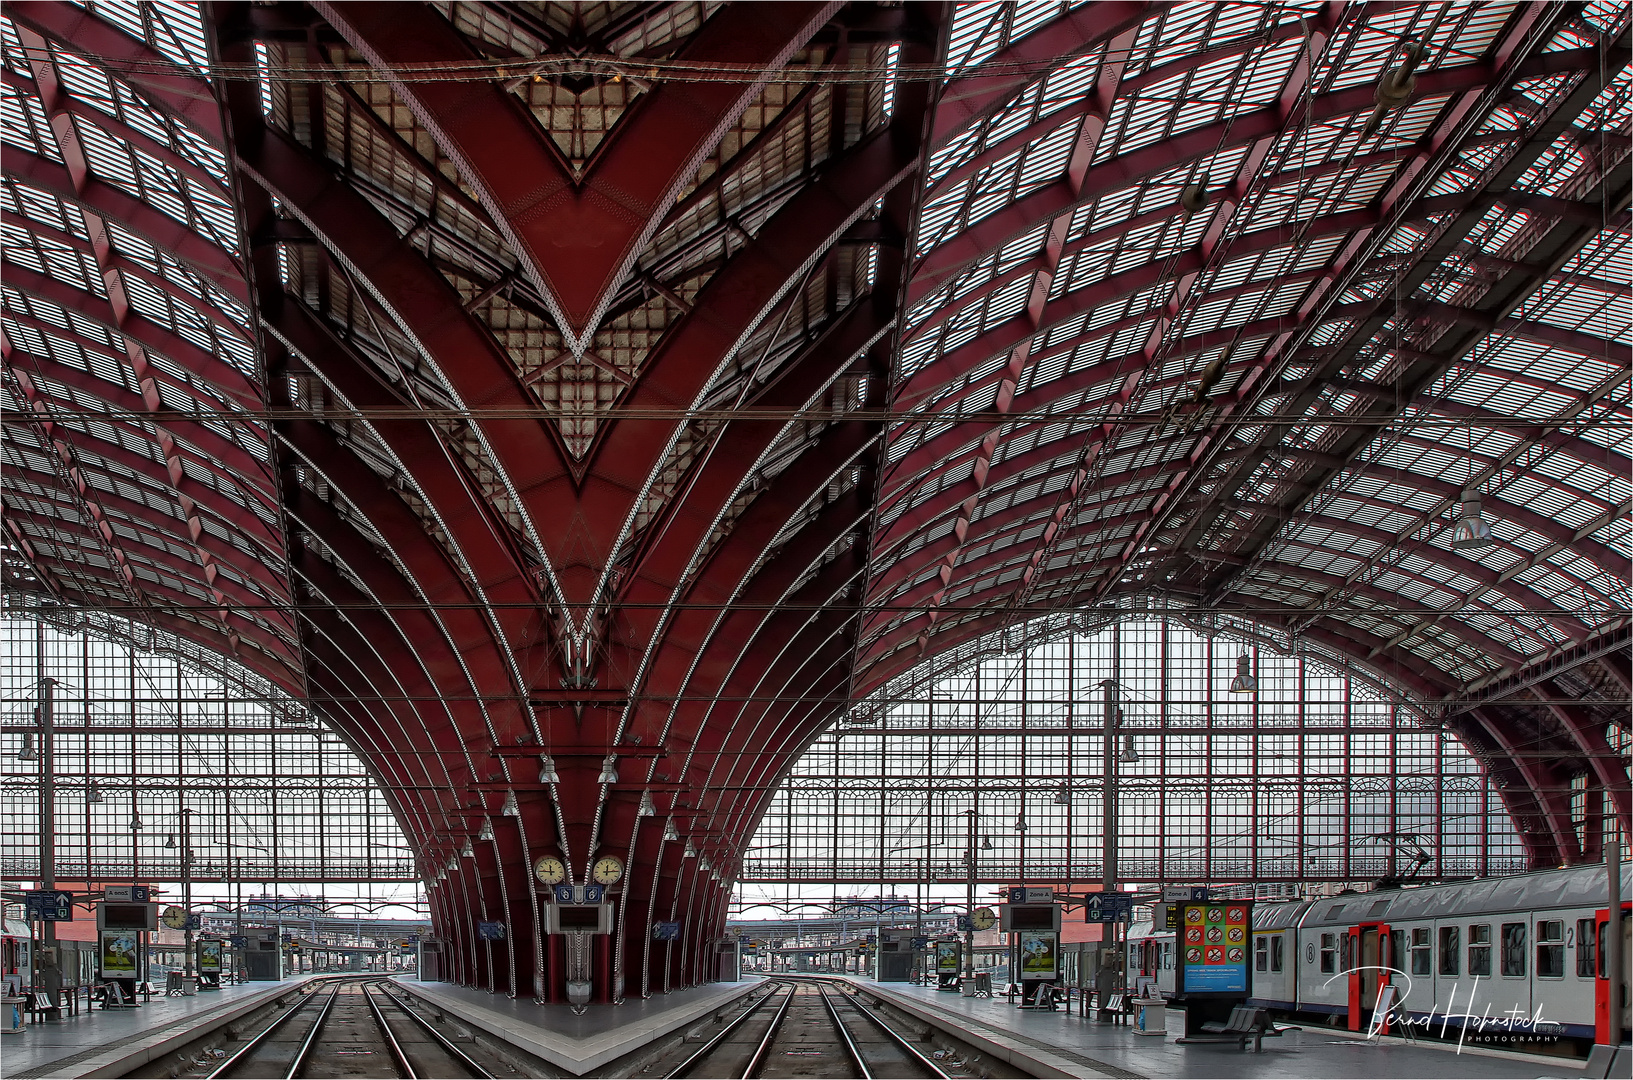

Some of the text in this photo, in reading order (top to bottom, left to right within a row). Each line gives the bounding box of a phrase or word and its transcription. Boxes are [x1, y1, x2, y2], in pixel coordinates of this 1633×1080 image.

[1014, 891, 1021, 900] 5
[1195, 890, 1203, 899] 4
[1406, 935, 1411, 952] 2
[1567, 926, 1574, 949] 2
[1336, 938, 1340, 953] 2
